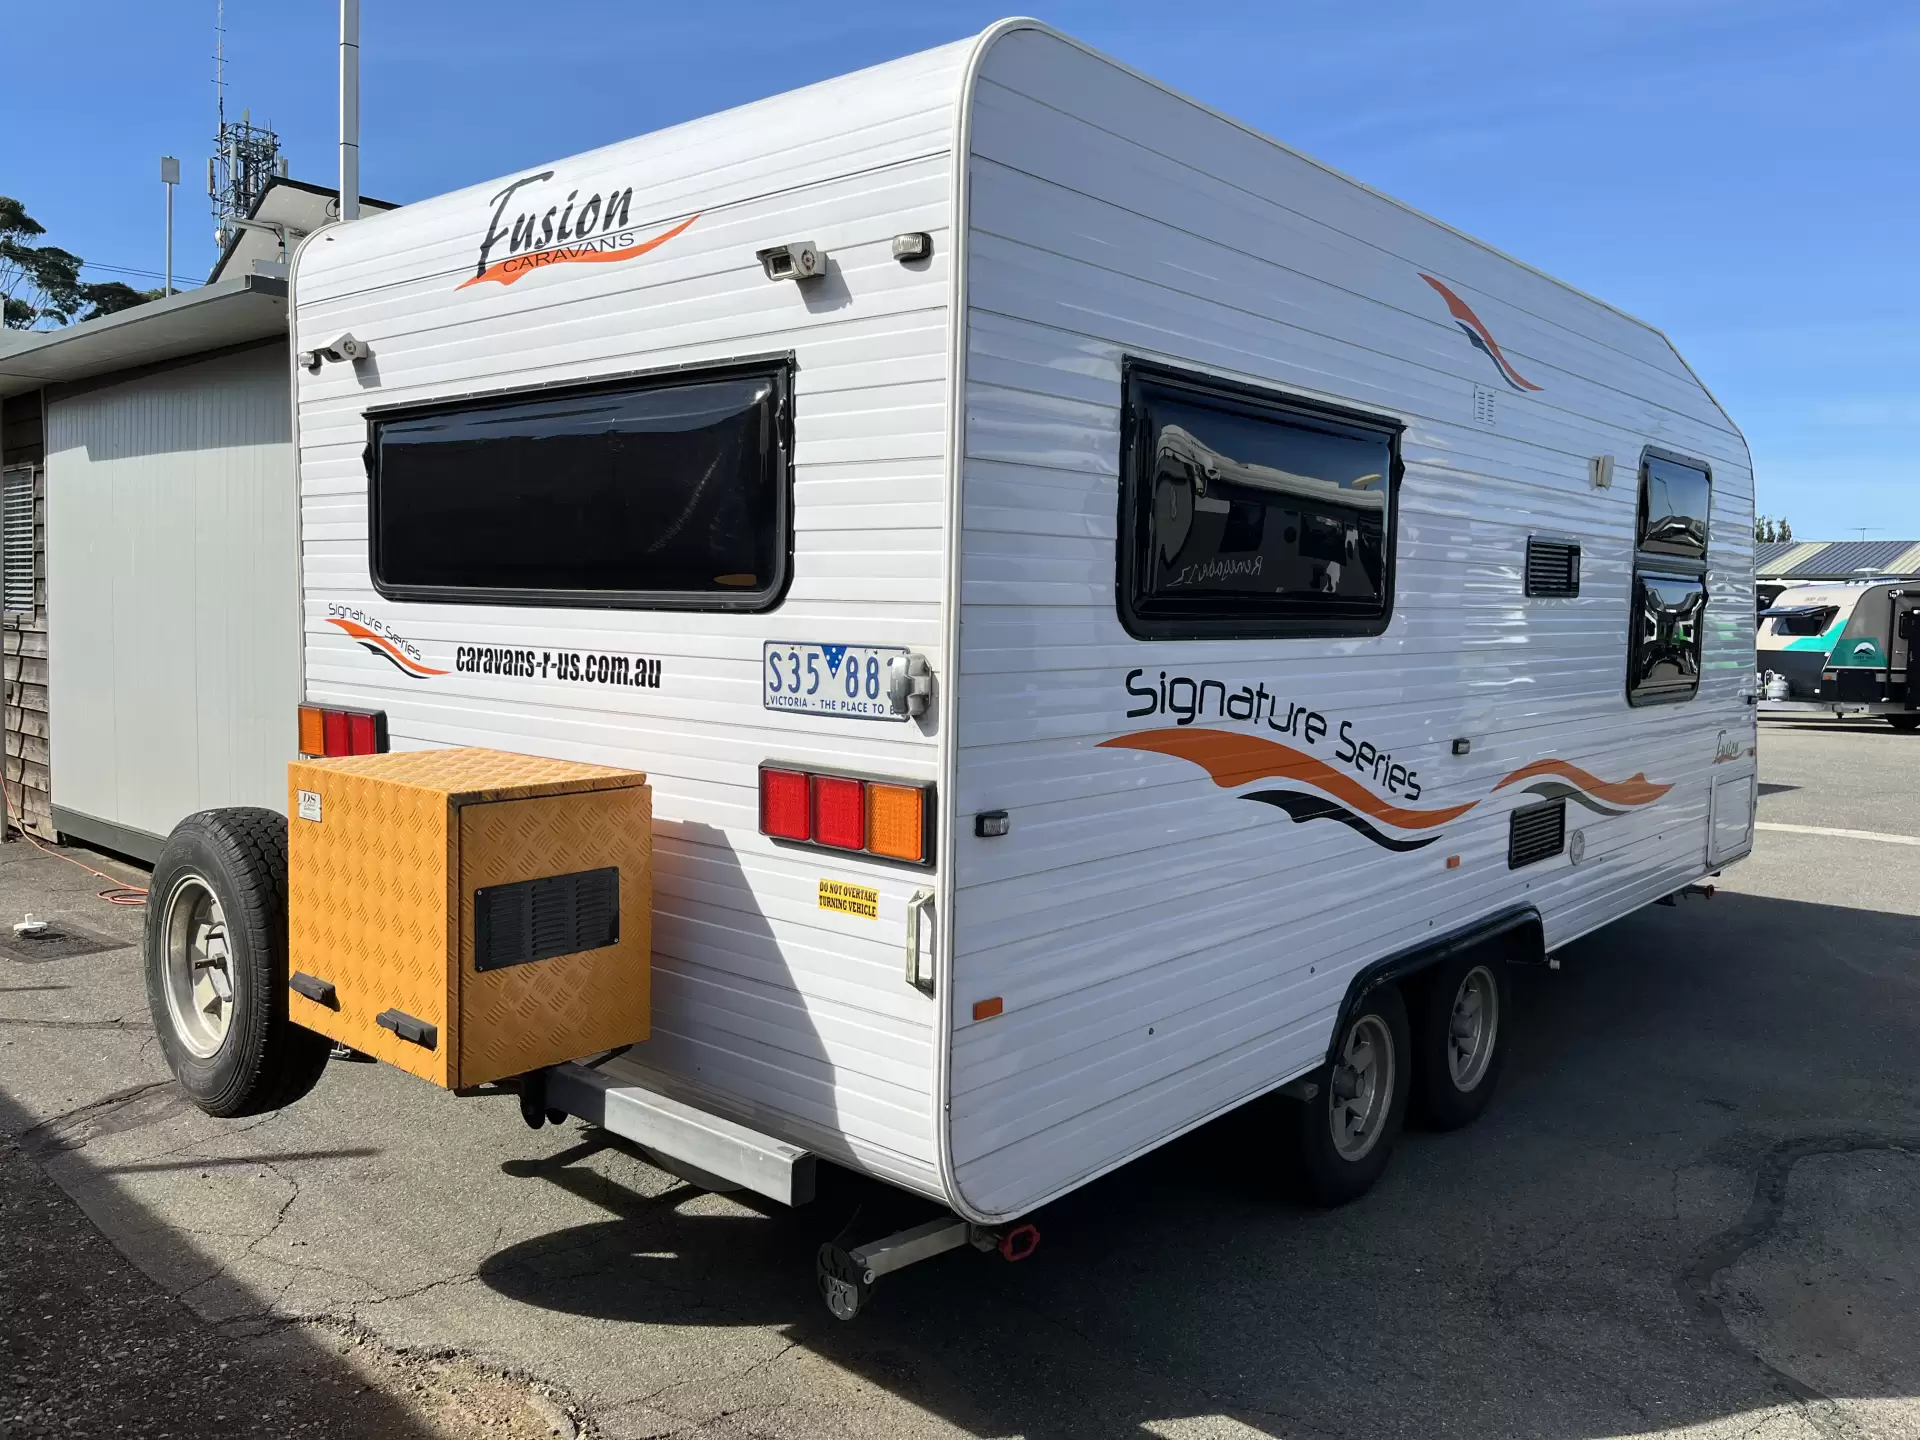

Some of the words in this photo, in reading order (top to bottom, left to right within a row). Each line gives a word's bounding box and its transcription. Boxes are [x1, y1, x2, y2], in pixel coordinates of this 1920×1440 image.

[477, 171, 633, 278] Fusion
[503, 232, 635, 273] CARAVANS
[328, 602, 382, 632] Signature
[384, 625, 421, 661] Series
[456, 645, 662, 688] caravans-r-us.com.au
[770, 696, 808, 708] VICTORIA
[820, 699, 837, 711] THE
[841, 701, 868, 713] PLACE
[872, 703, 885, 714] TO
[1126, 669, 1327, 745] Signature
[1335, 720, 1422, 801] Series
[819, 881, 828, 892] DO
[829, 883, 842, 895] NOT
[843, 886, 877, 903] OVERTAKE
[819, 895, 847, 910] TURNING
[848, 900, 876, 917] VEHICLE
